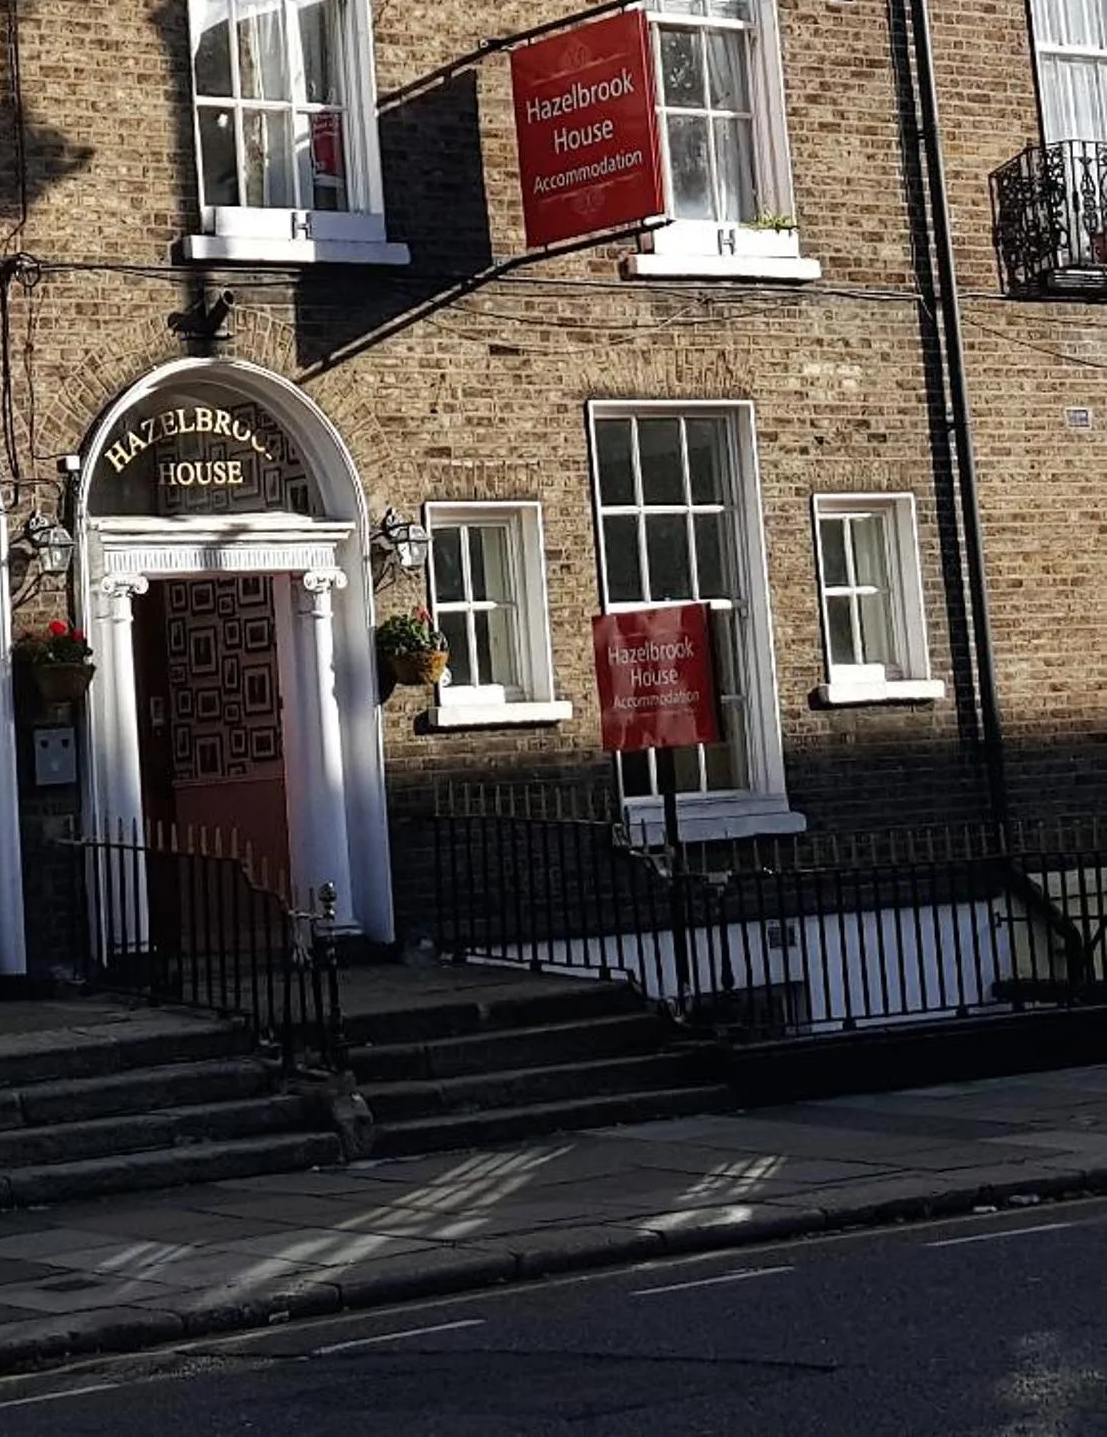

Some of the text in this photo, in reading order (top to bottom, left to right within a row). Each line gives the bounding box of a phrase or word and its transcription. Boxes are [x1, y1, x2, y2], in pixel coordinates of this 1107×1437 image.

[526, 68, 634, 124] Hazelbrook
[554, 119, 613, 154] House
[533, 150, 642, 193] Accommodation
[159, 460, 243, 486] HOUSE
[608, 636, 694, 666] Hazelbrook
[630, 667, 678, 687] House
[613, 690, 699, 710] Accommodation
